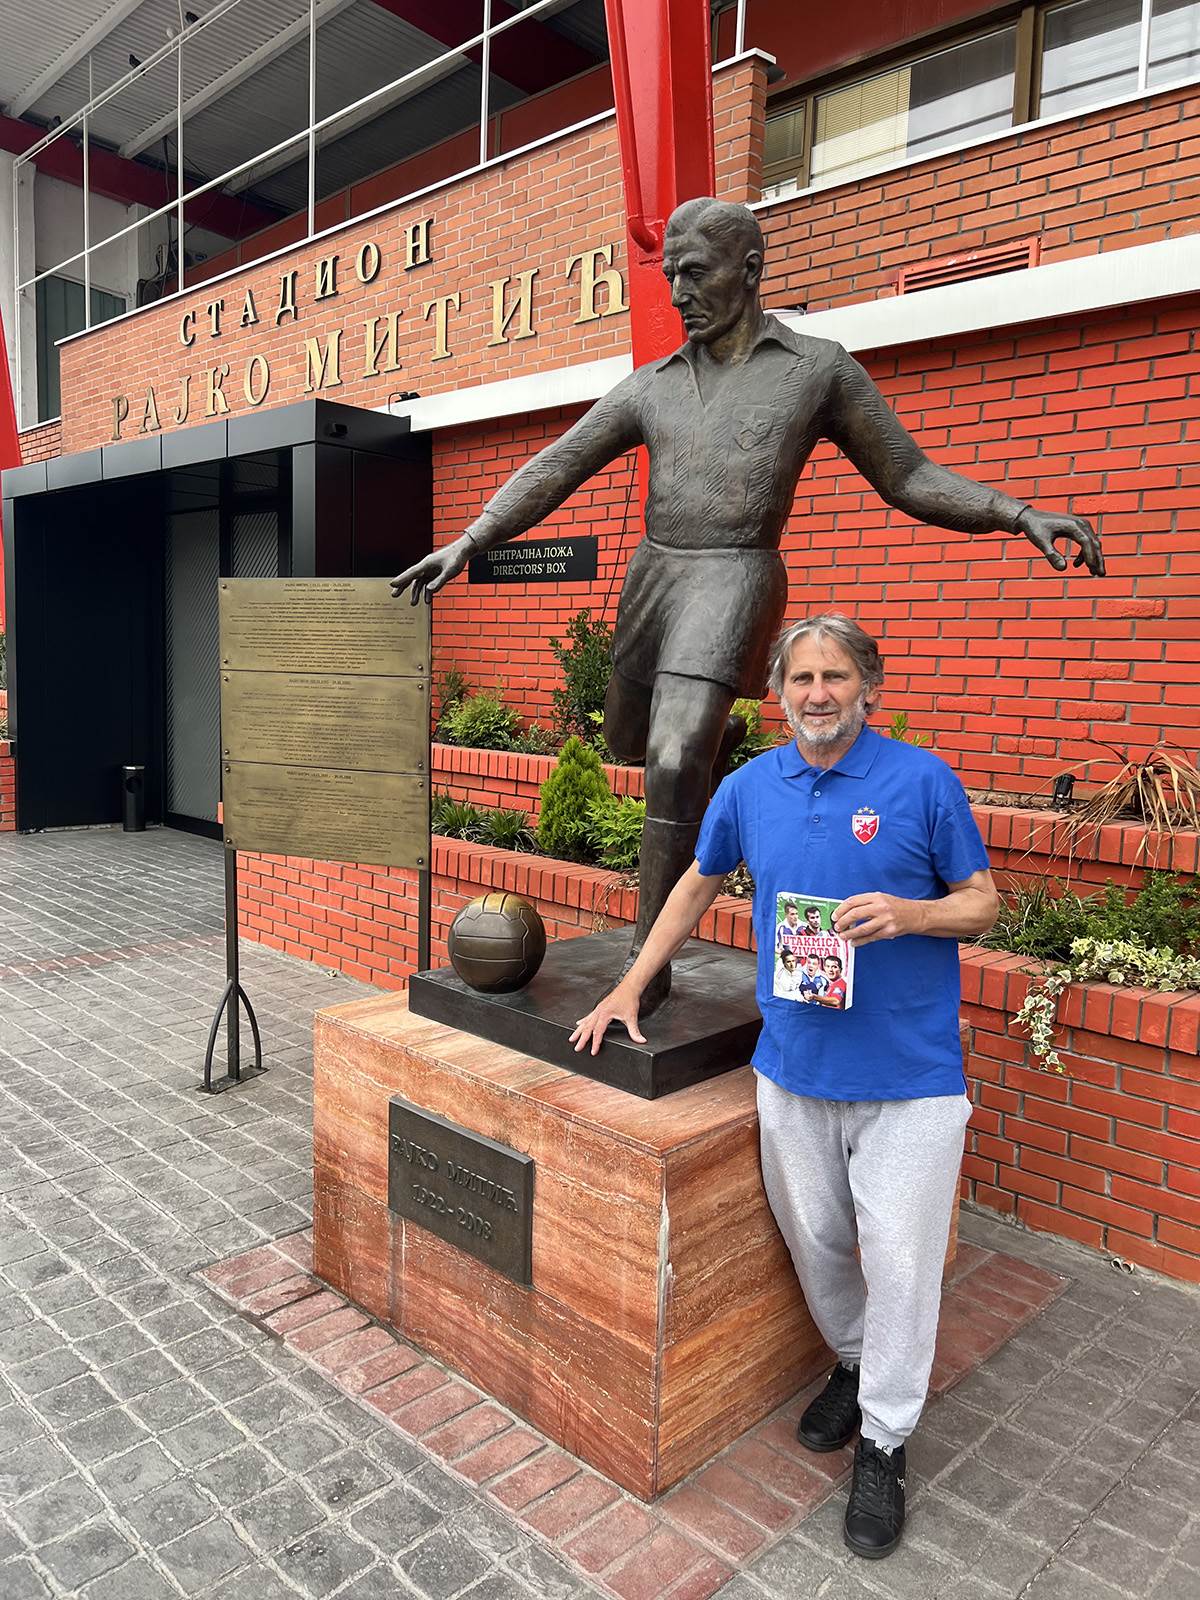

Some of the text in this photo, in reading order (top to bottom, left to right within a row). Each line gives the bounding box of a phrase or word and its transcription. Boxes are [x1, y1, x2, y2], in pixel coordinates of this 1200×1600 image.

[179, 218, 434, 346] СТАДИОН
[111, 243, 630, 441] РАЈКО МИТИЋ
[487, 546, 573, 562] ЦЕНТРАЛНА ЛОЖА
[547, 562, 566, 574] BOX
[783, 936, 840, 947] UTAKMICA
[391, 1134, 438, 1172] РАЈКО
